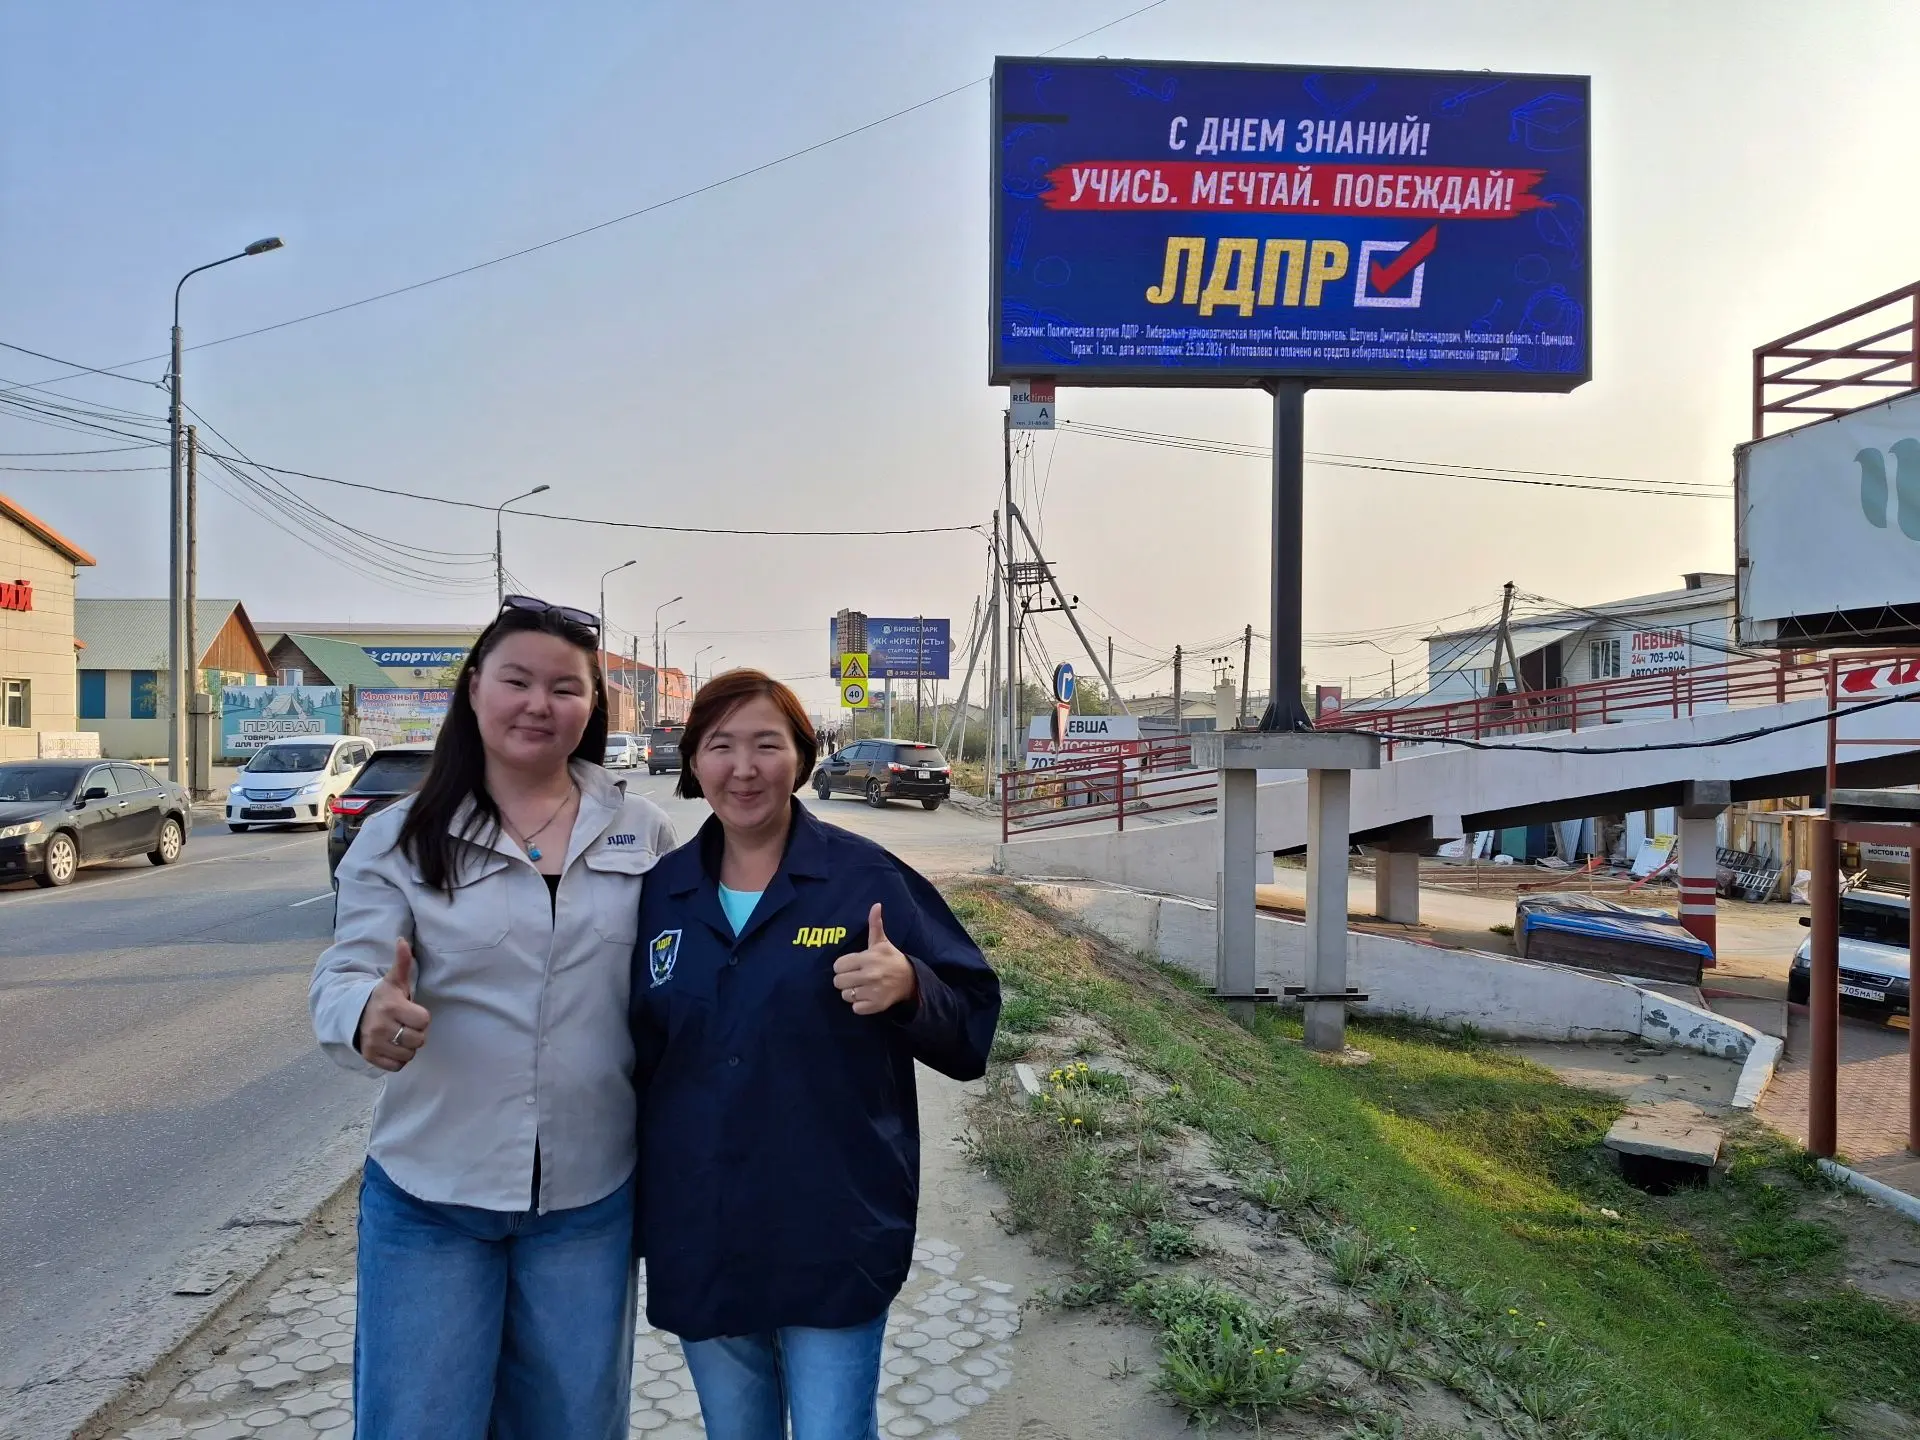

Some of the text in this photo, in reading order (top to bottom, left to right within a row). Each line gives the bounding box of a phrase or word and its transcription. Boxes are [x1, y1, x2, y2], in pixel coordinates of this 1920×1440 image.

[1169, 115, 1431, 156] С ДНЕМ ЗНАНИЙ!
[1070, 165, 1514, 214] УЧИСЬ. МЕЧТАЙ. ПОБЕЖДАЙ!
[1146, 236, 1350, 316] ЛДПР
[1047, 323, 1094, 339] Политическая
[1096, 326, 1119, 341] партия
[1121, 324, 1140, 340] ЛДПР
[1250, 328, 1272, 343] партия
[1464, 330, 1504, 344] Московская
[872, 637, 887, 645] ЖК
[1631, 630, 1685, 651] ЛЕВША
[1649, 650, 1685, 663] 703-904
[849, 690, 859, 698] 40
[243, 720, 321, 733] ПРИВАЛ
[1064, 720, 1109, 737] ЕВША
[607, 834, 636, 846] ЛДПР
[655, 935, 673, 951] ЛДПР
[792, 926, 847, 948] ЛДПР
